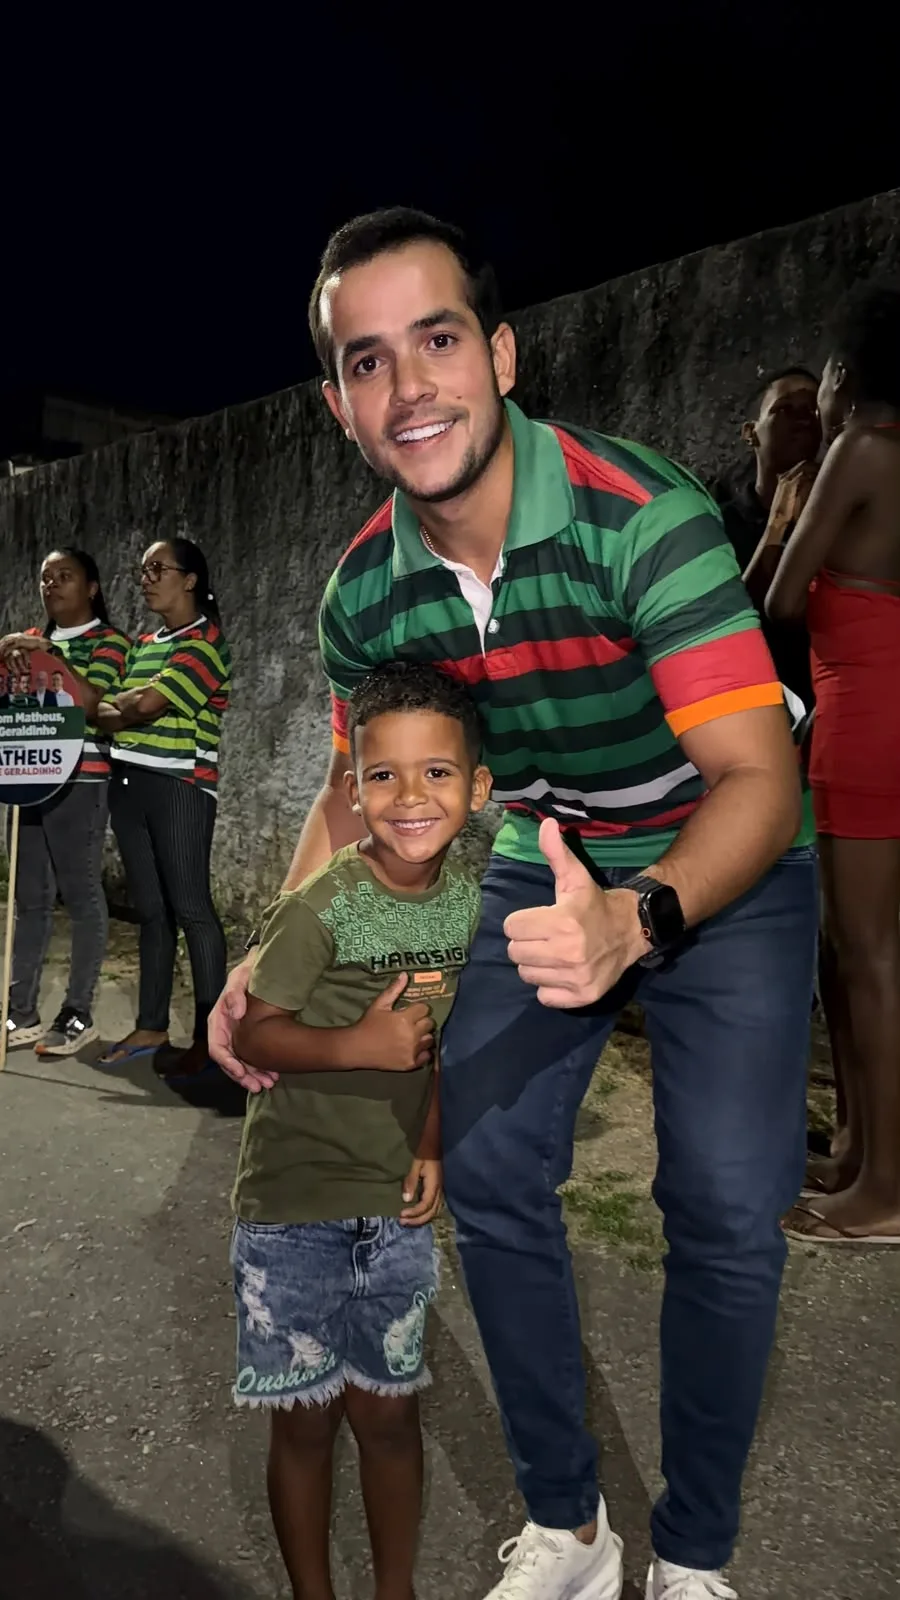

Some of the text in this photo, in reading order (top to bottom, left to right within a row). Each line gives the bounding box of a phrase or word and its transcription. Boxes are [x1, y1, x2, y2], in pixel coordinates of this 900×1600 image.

[0, 712, 65, 724] om Matheus,
[0, 725, 57, 736] Geraldinho
[4, 767, 62, 776] GERALDINHO
